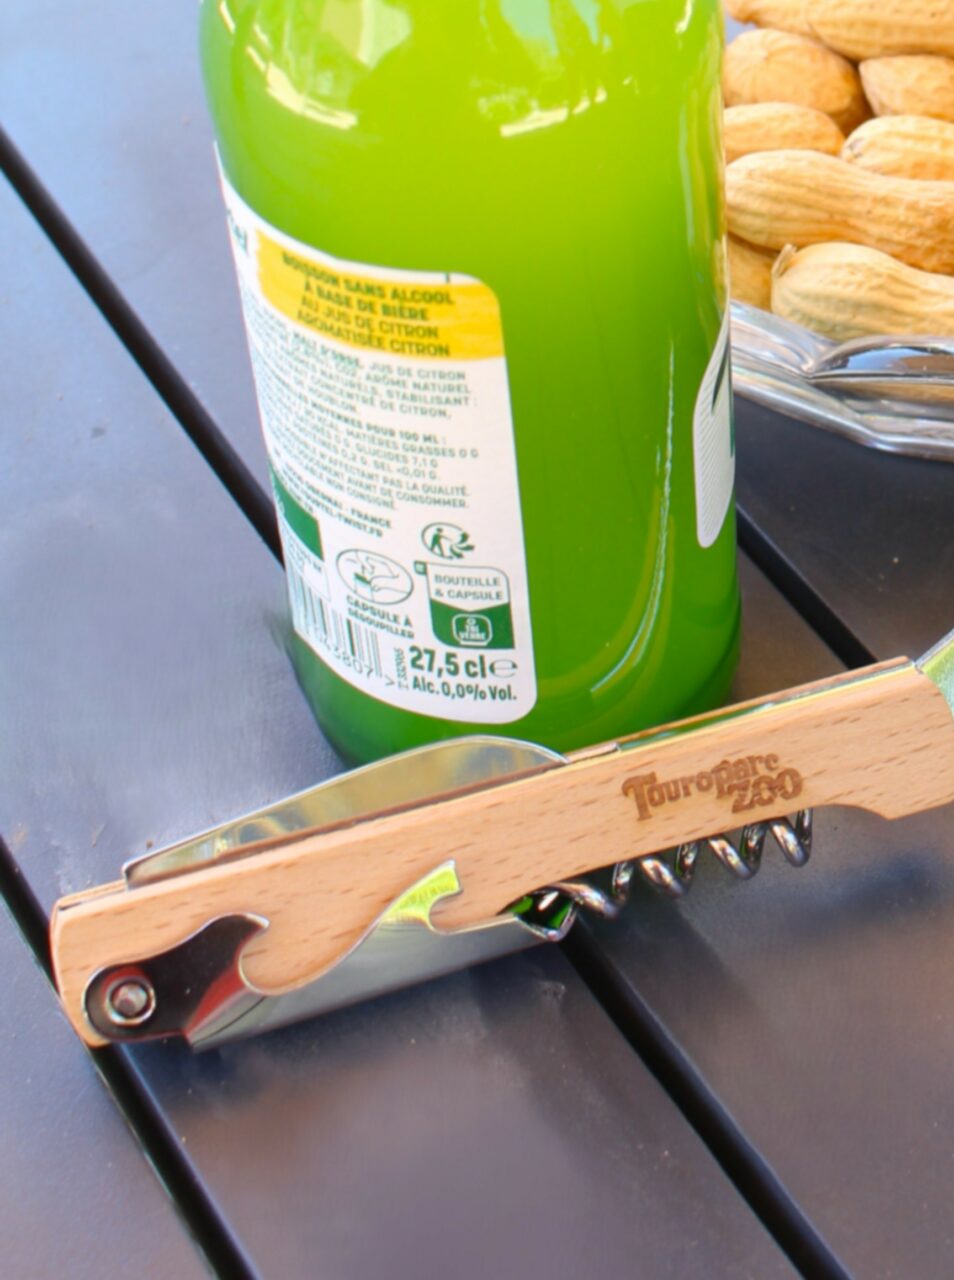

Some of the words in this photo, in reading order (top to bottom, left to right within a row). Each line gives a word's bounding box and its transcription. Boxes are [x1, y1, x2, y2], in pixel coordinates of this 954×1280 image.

[316, 285, 353, 309] BASE
[357, 298, 376, 314] DE
[381, 300, 429, 322] BIÈRE
[343, 277, 386, 299] SANS
[391, 287, 454, 305] ALCOOL
[322, 304, 351, 325] JUS
[355, 315, 375, 332] DE
[379, 320, 440, 340] CITRON
[390, 338, 451, 359] CITRON
[397, 365, 412, 377] DE
[417, 369, 467, 381] CITRON
[386, 388, 470, 407] STABILISANT
[406, 479, 419, 492] LA
[434, 573, 500, 588] BOUTEILLE
[434, 587, 445, 599] &
[447, 588, 504, 601] CAPSULE
[346, 593, 401, 624] CAPSULE
[408, 644, 461, 679] 27,5
[464, 653, 487, 679] cl
[621, 753, 780, 822] Touroparc
[727, 767, 804, 815] ZOO
